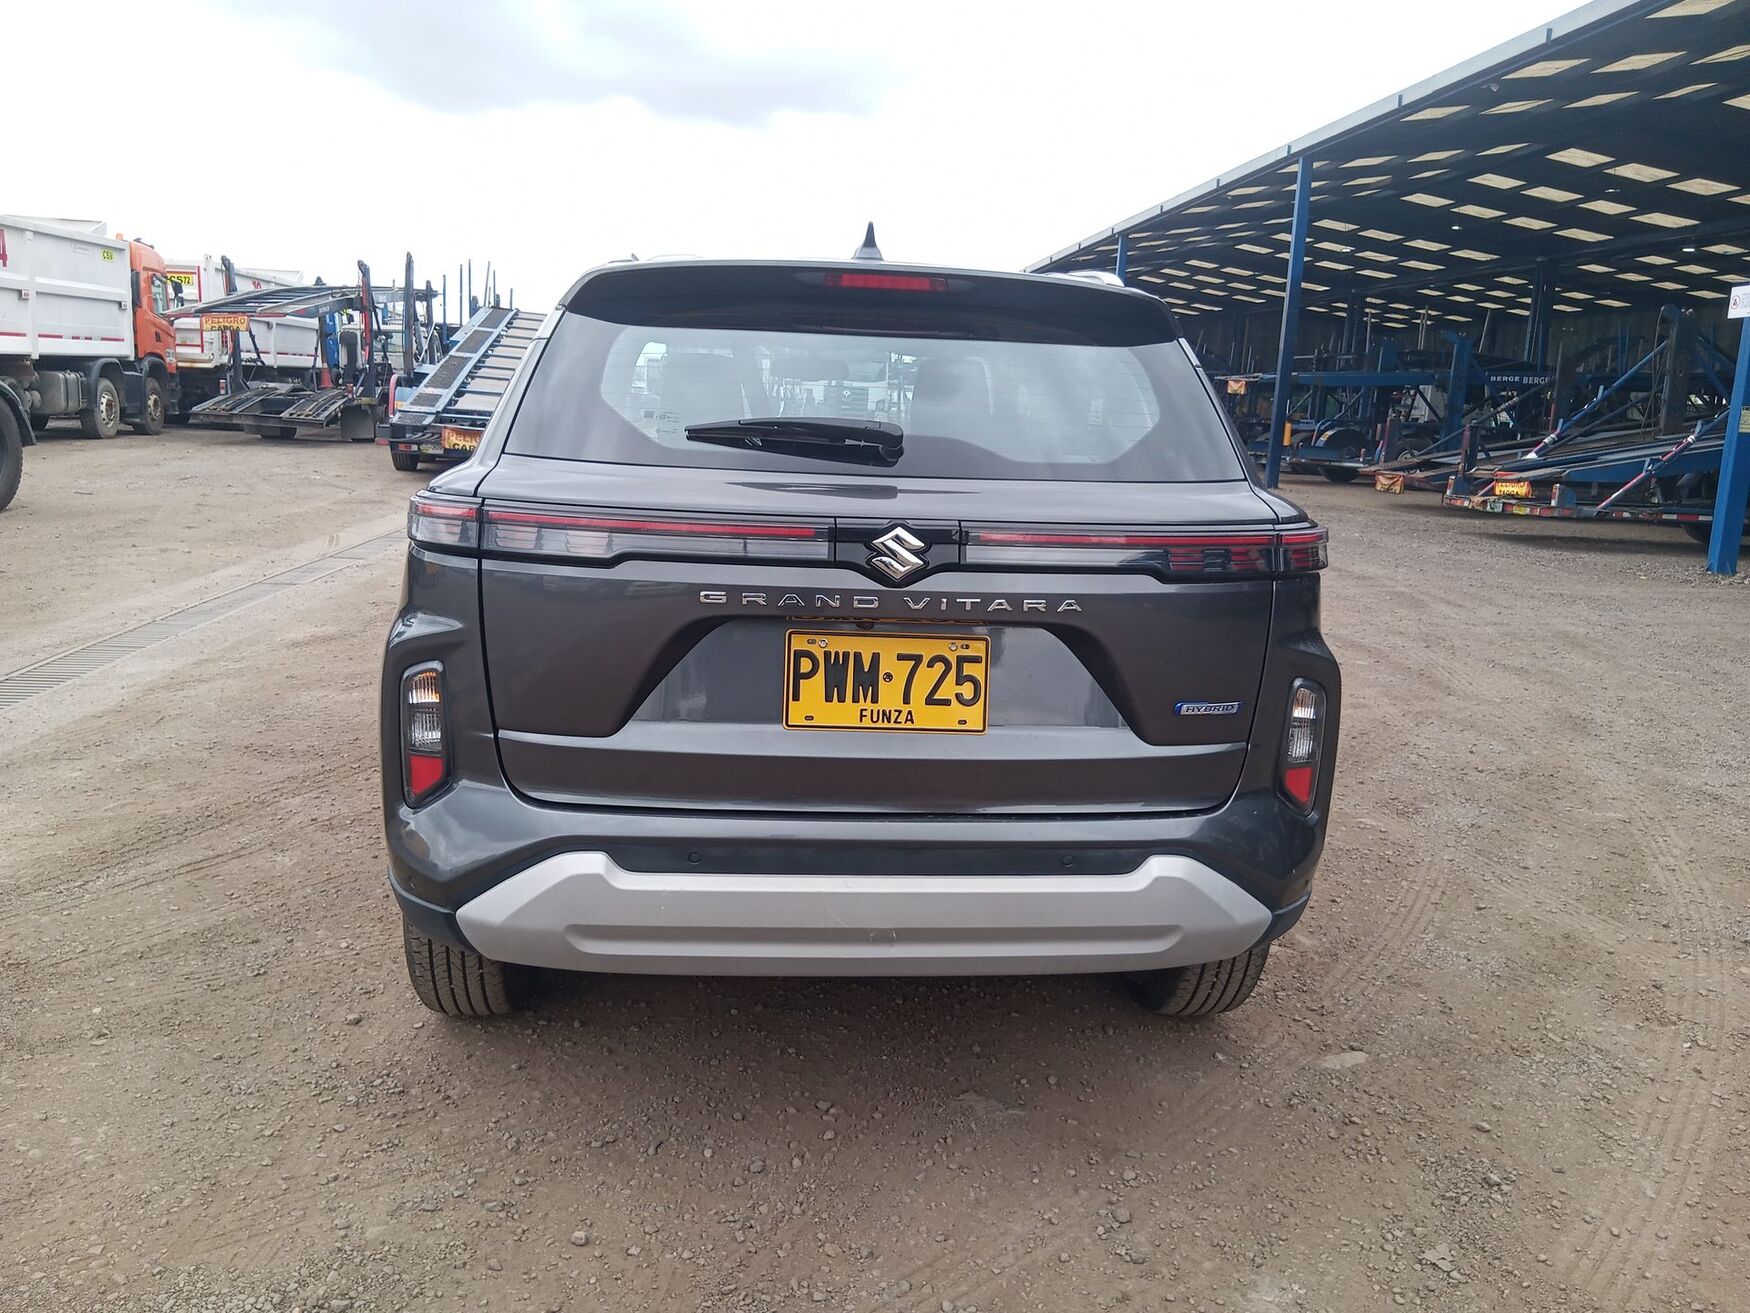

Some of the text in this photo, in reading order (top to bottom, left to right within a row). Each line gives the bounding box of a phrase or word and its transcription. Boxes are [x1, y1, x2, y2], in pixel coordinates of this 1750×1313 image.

[205, 316, 246, 324] PELIGRO
[699, 590, 1082, 613] GRAND VITARA
[791, 648, 983, 708] PWM 725
[859, 708, 915, 725] FUNZA
[1185, 704, 1235, 713] HYBRID
